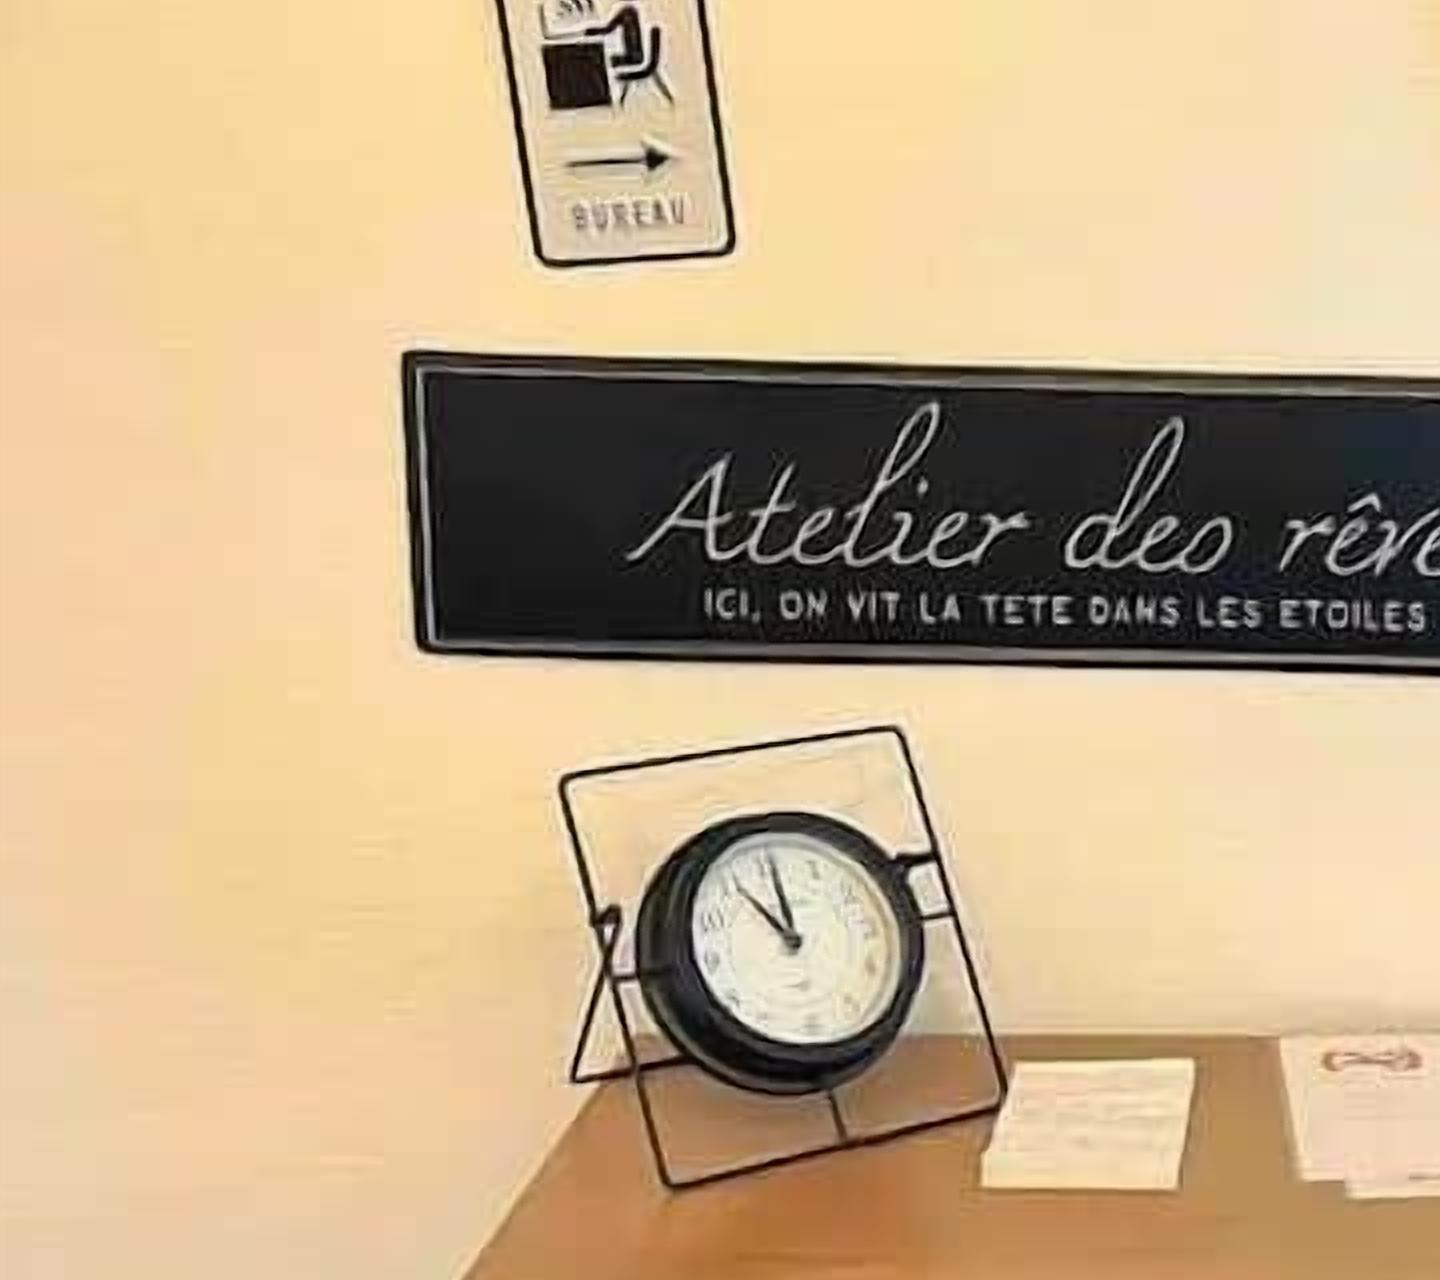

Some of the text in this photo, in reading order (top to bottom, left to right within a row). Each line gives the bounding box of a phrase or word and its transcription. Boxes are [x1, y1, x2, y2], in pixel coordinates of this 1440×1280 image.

[571, 197, 684, 231] BUREAU
[625, 401, 1029, 568] Atelier
[1065, 416, 1233, 573] des
[704, 588, 1426, 632] ICI, ON VIT LA TETE DANS LES ETOILES
